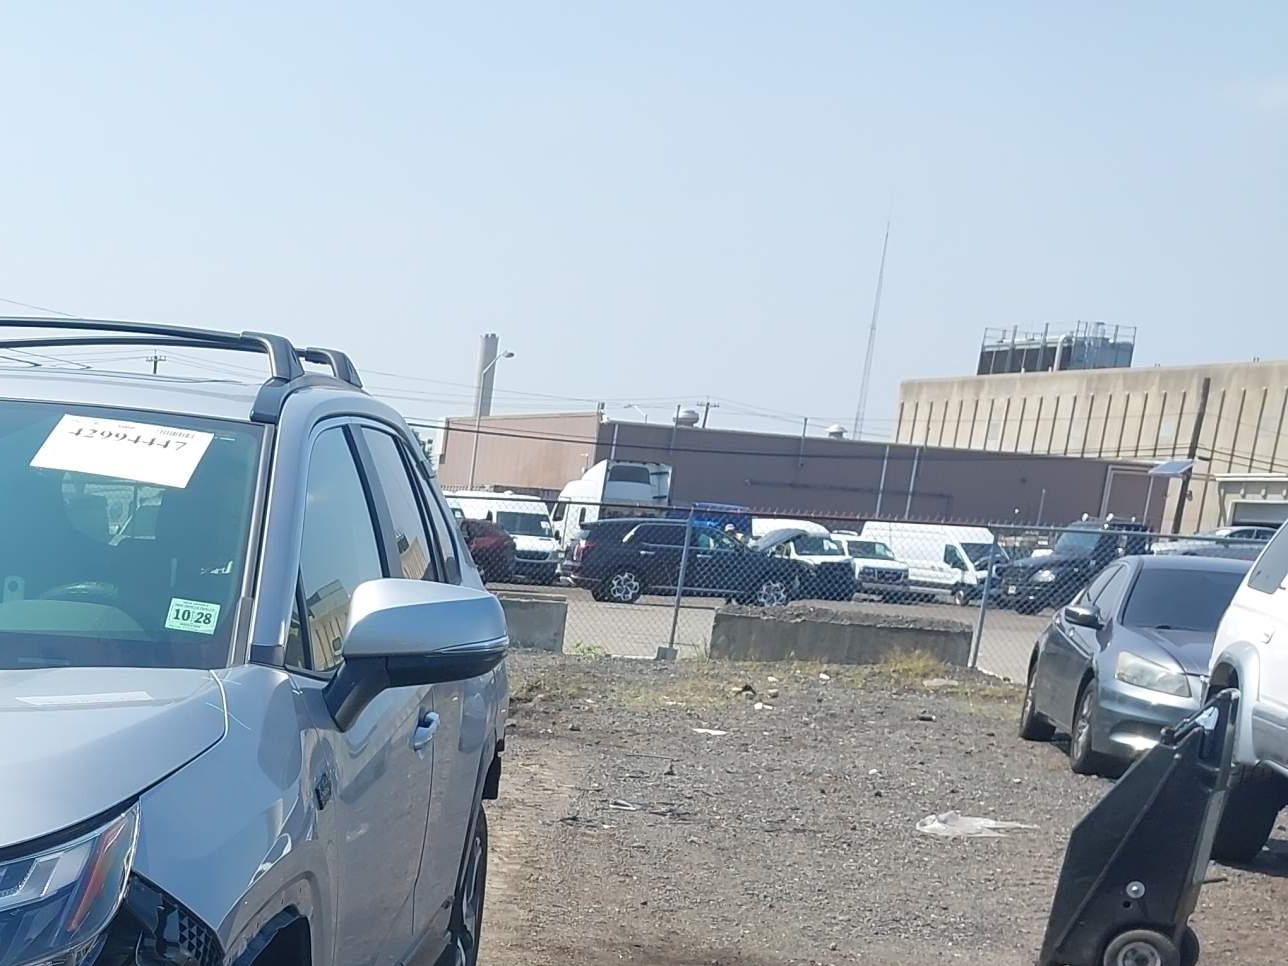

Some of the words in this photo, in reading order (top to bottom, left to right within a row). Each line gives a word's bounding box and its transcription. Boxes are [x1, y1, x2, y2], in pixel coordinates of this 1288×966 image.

[68, 428, 188, 451] 42994447
[173, 608, 191, 622] 10
[194, 611, 213, 625] 28
